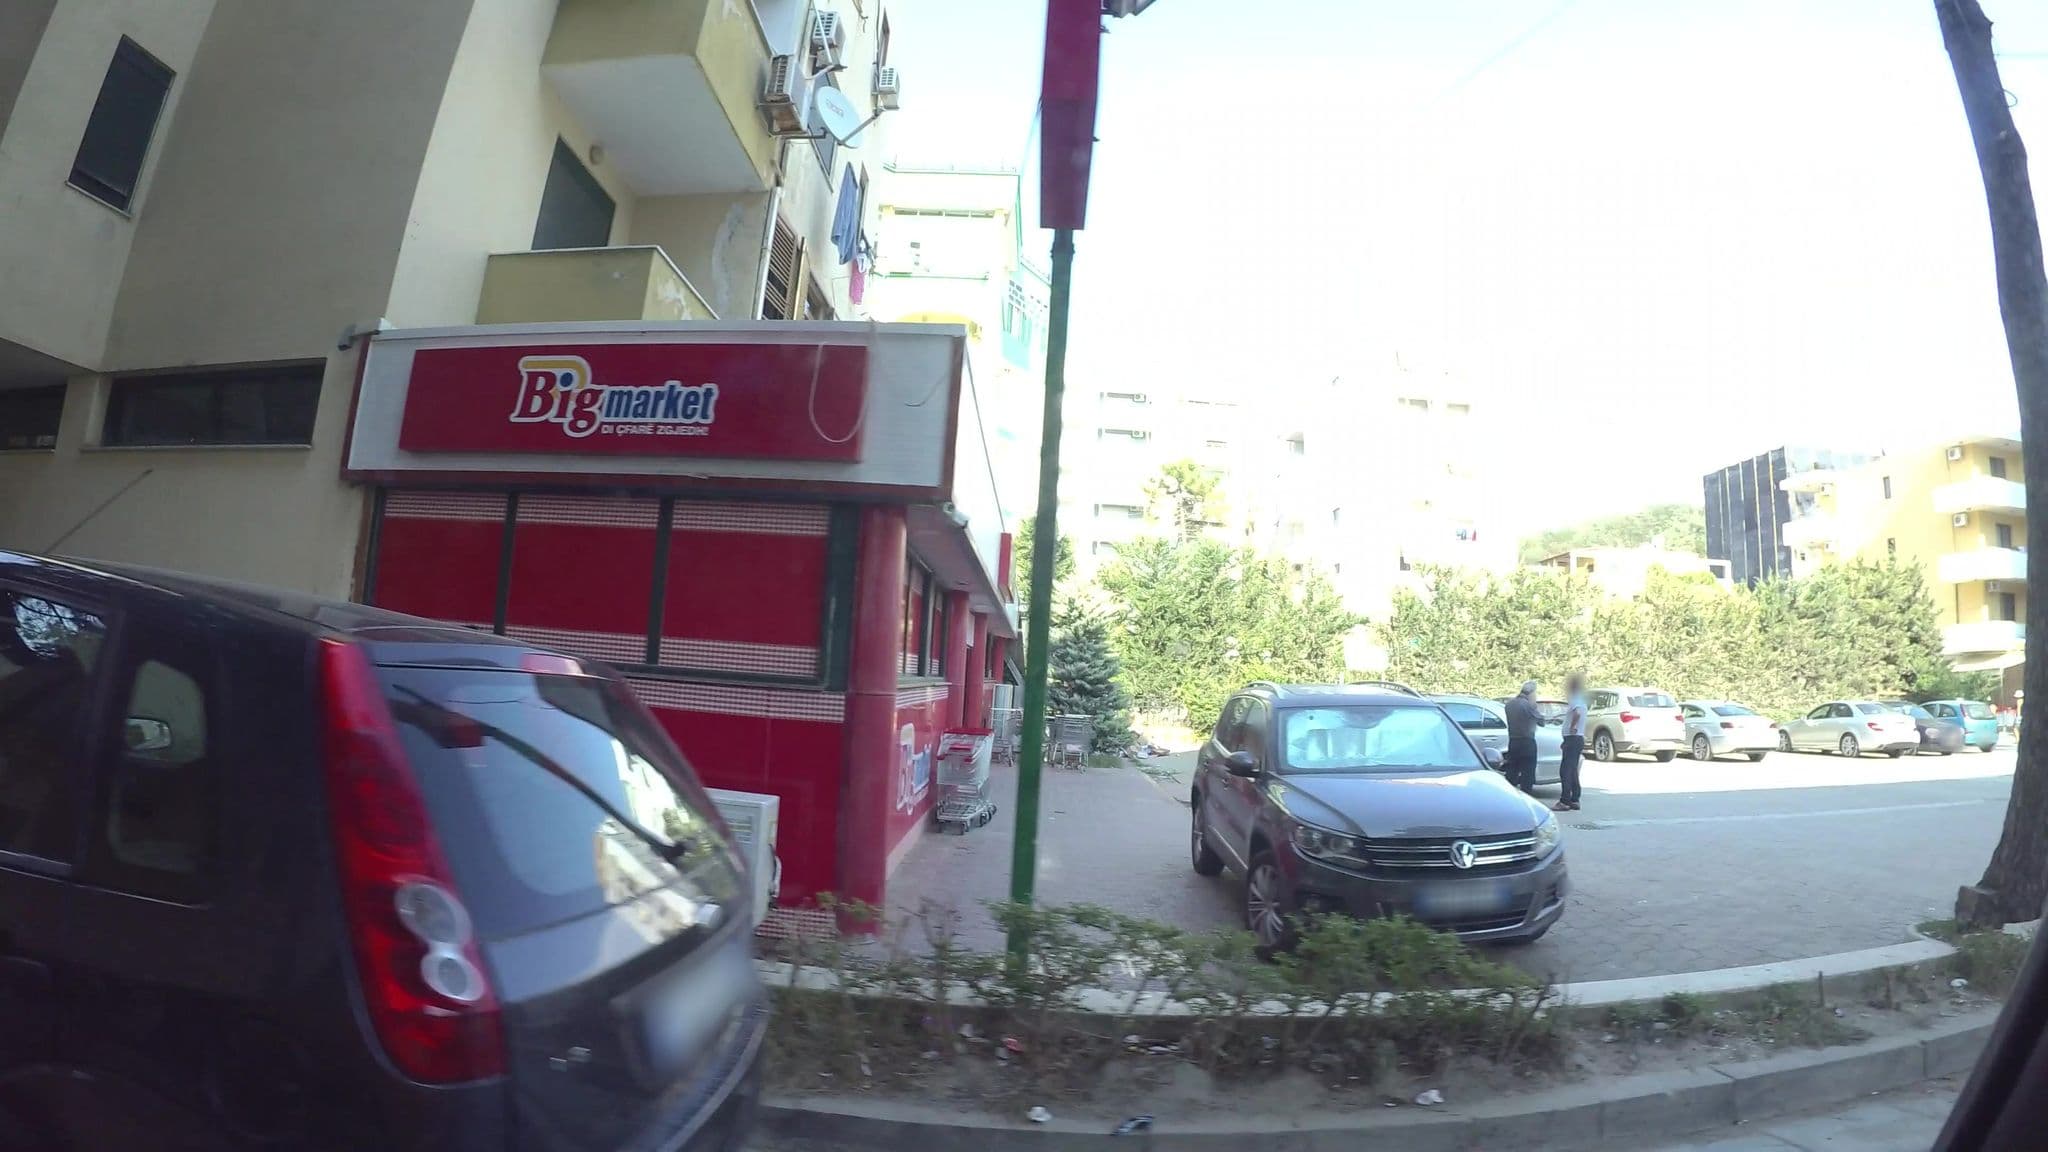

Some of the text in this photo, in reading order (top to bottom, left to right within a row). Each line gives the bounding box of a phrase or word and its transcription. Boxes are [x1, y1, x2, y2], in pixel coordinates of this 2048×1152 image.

[511, 359, 715, 436] Big market
[601, 424, 614, 434] DI
